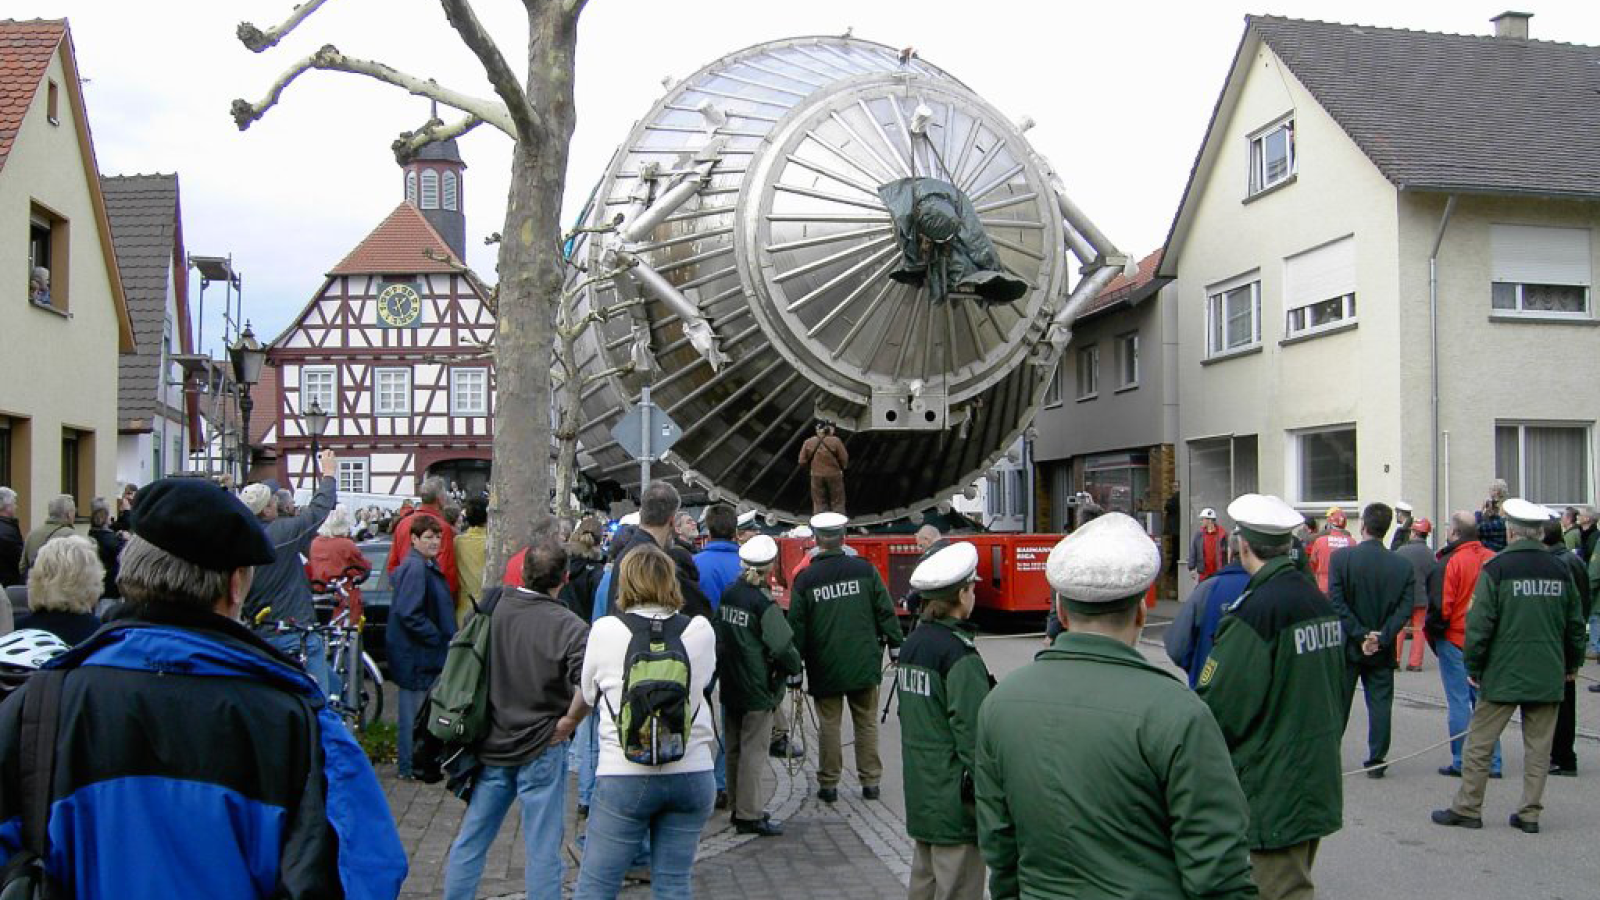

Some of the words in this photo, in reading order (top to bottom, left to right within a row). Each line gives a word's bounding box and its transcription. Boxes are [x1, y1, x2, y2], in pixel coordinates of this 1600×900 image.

[813, 579, 860, 603] POLIZEI
[1513, 579, 1562, 597] POLIZEI
[1294, 620, 1342, 655] POLIZEI
